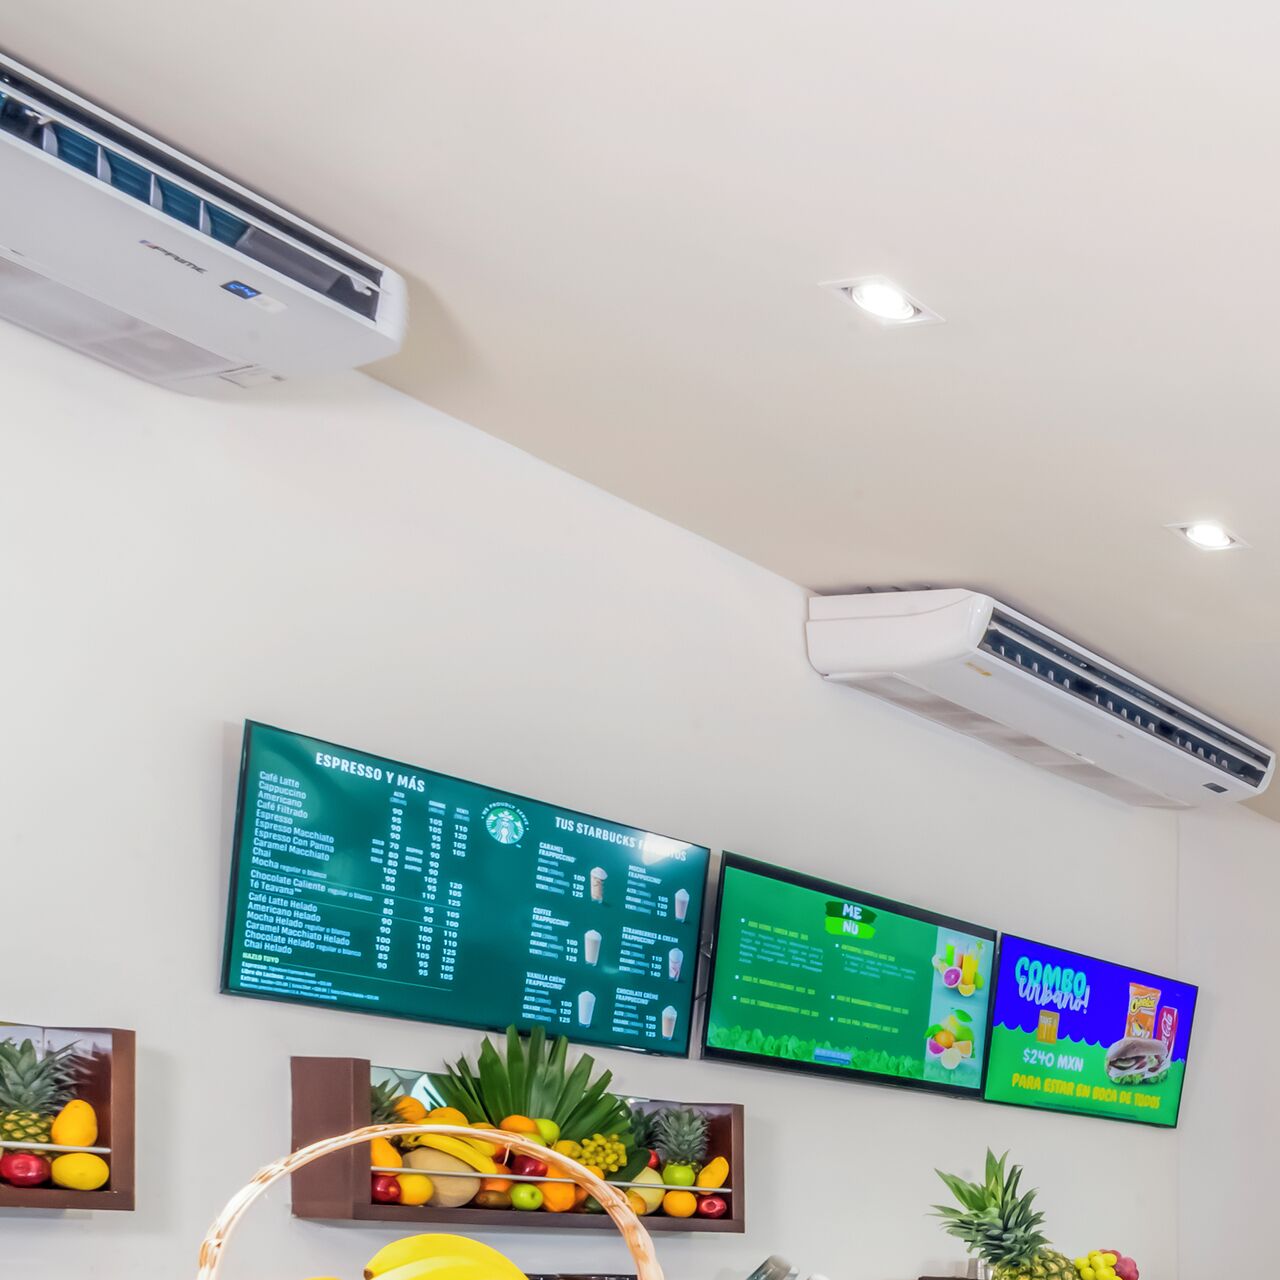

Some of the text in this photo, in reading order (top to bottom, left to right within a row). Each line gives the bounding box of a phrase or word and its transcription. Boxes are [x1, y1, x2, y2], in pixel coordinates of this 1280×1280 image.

[260, 770, 300, 788] Café Latte
[315, 752, 425, 793] ESPRESSO Y MÁS
[258, 780, 306, 800] Cappuccino
[258, 790, 302, 808] Americano
[256, 800, 308, 819] Café Filtrado
[256, 809, 293, 825] Espresso
[255, 818, 334, 844] Espresso Macchiato
[429, 818, 442, 826] 105
[455, 824, 468, 832] 110
[429, 826, 441, 834] 105
[454, 832, 467, 840] 120
[555, 816, 636, 848] TUS STARBUCKS
[253, 837, 330, 861] Caramel Macchiato
[254, 828, 334, 853] Espresso Con Panna
[389, 842, 399, 850] 70
[390, 832, 400, 840] 90
[453, 849, 465, 857] 105
[454, 841, 466, 850] 105
[252, 847, 271, 858] Chai
[252, 856, 279, 869] Mocha
[249, 879, 259, 889] Té
[250, 869, 291, 886] Chocolate
[293, 877, 326, 892] Caliente
[383, 867, 462, 890] 100 105 120
[248, 892, 318, 913] Café Latte Helado
[422, 892, 435, 900] 110
[448, 899, 460, 907] 125
[247, 902, 321, 923] Americano Helado
[247, 911, 274, 923] Mocha
[275, 916, 303, 929] Helado
[842, 904, 862, 920] ME
[246, 920, 350, 946] Caramel Macchiato Helado
[446, 920, 459, 928] 100
[842, 920, 859, 935] NU
[245, 930, 286, 945] Chocolate
[287, 938, 315, 949] Helado
[380, 926, 391, 934] 90
[444, 939, 457, 947] 110
[444, 930, 457, 938] 110
[244, 939, 292, 954] Chai Helado
[376, 936, 390, 944] 100
[443, 948, 456, 956] 125
[376, 944, 390, 952] 100
[1015, 956, 1087, 998] COMBO
[1023, 1048, 1084, 1072] $240 MXN
[1012, 1073, 1160, 1109] PARA ESTAR EN BOCA DE TODOS
